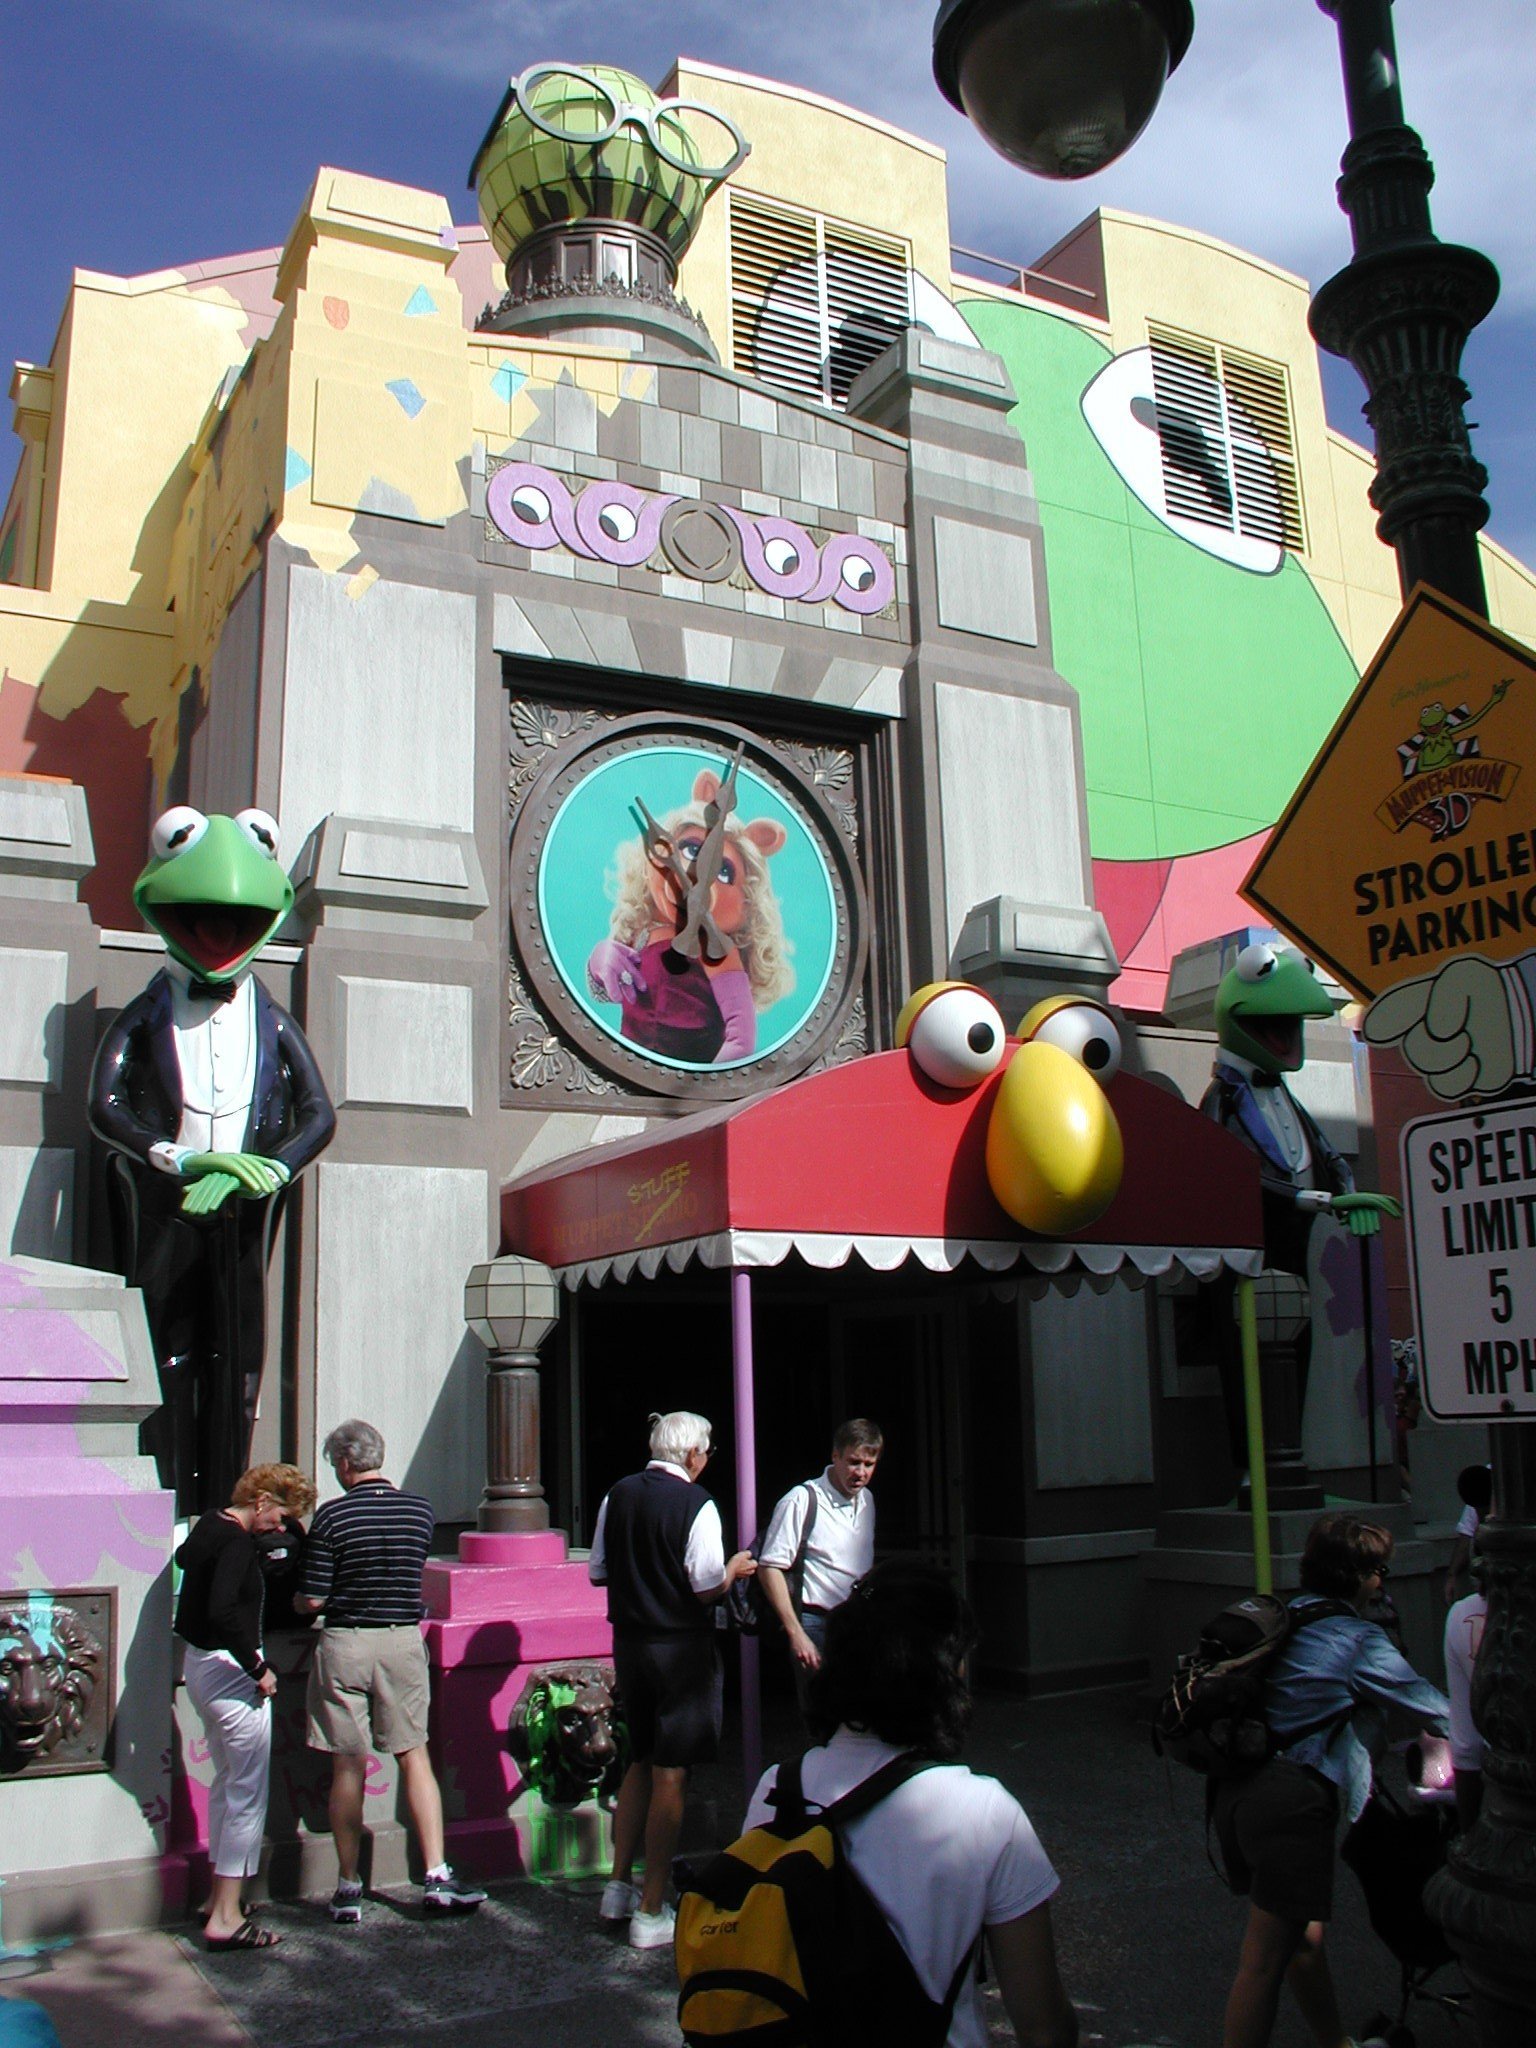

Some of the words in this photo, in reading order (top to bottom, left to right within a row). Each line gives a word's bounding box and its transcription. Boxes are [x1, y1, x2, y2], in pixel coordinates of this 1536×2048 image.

[1427, 792, 1472, 838] 3D
[627, 1161, 691, 1204] STUFF
[1429, 1126, 1536, 1194] SPEED
[1442, 1194, 1536, 1257] LIMIT
[1489, 1268, 1513, 1323] 5
[1463, 1338, 1536, 1395] MPH
